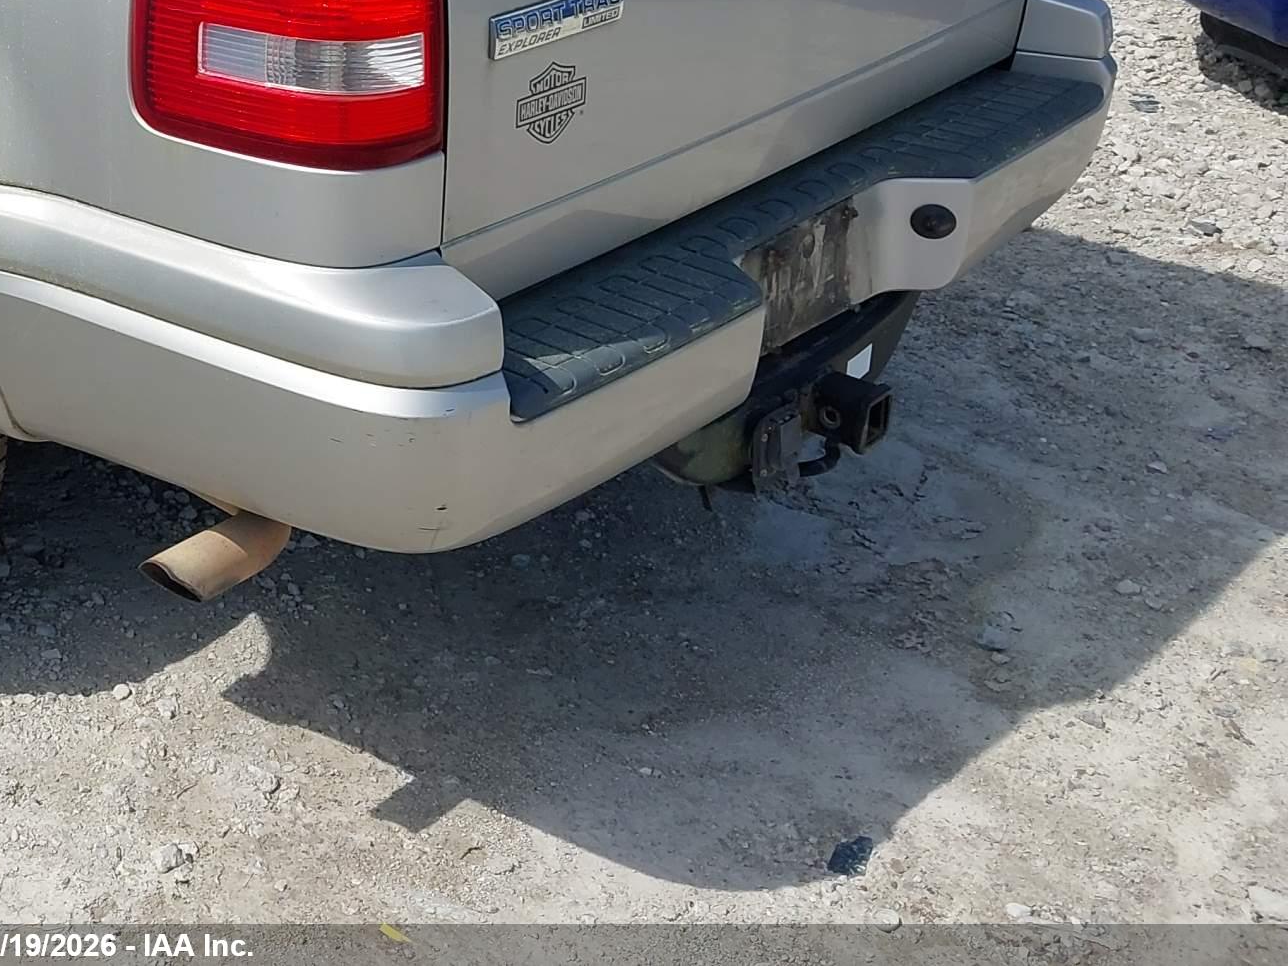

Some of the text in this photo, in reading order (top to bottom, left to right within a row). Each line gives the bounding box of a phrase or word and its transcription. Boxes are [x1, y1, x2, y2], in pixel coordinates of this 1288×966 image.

[496, 4, 566, 40] SPORT
[497, 7, 620, 56] EXPLORER LIMITED
[532, 71, 570, 94] MOTOR
[520, 84, 582, 121] HARLEY-DAVIDSON
[533, 111, 568, 137] CYCLES
